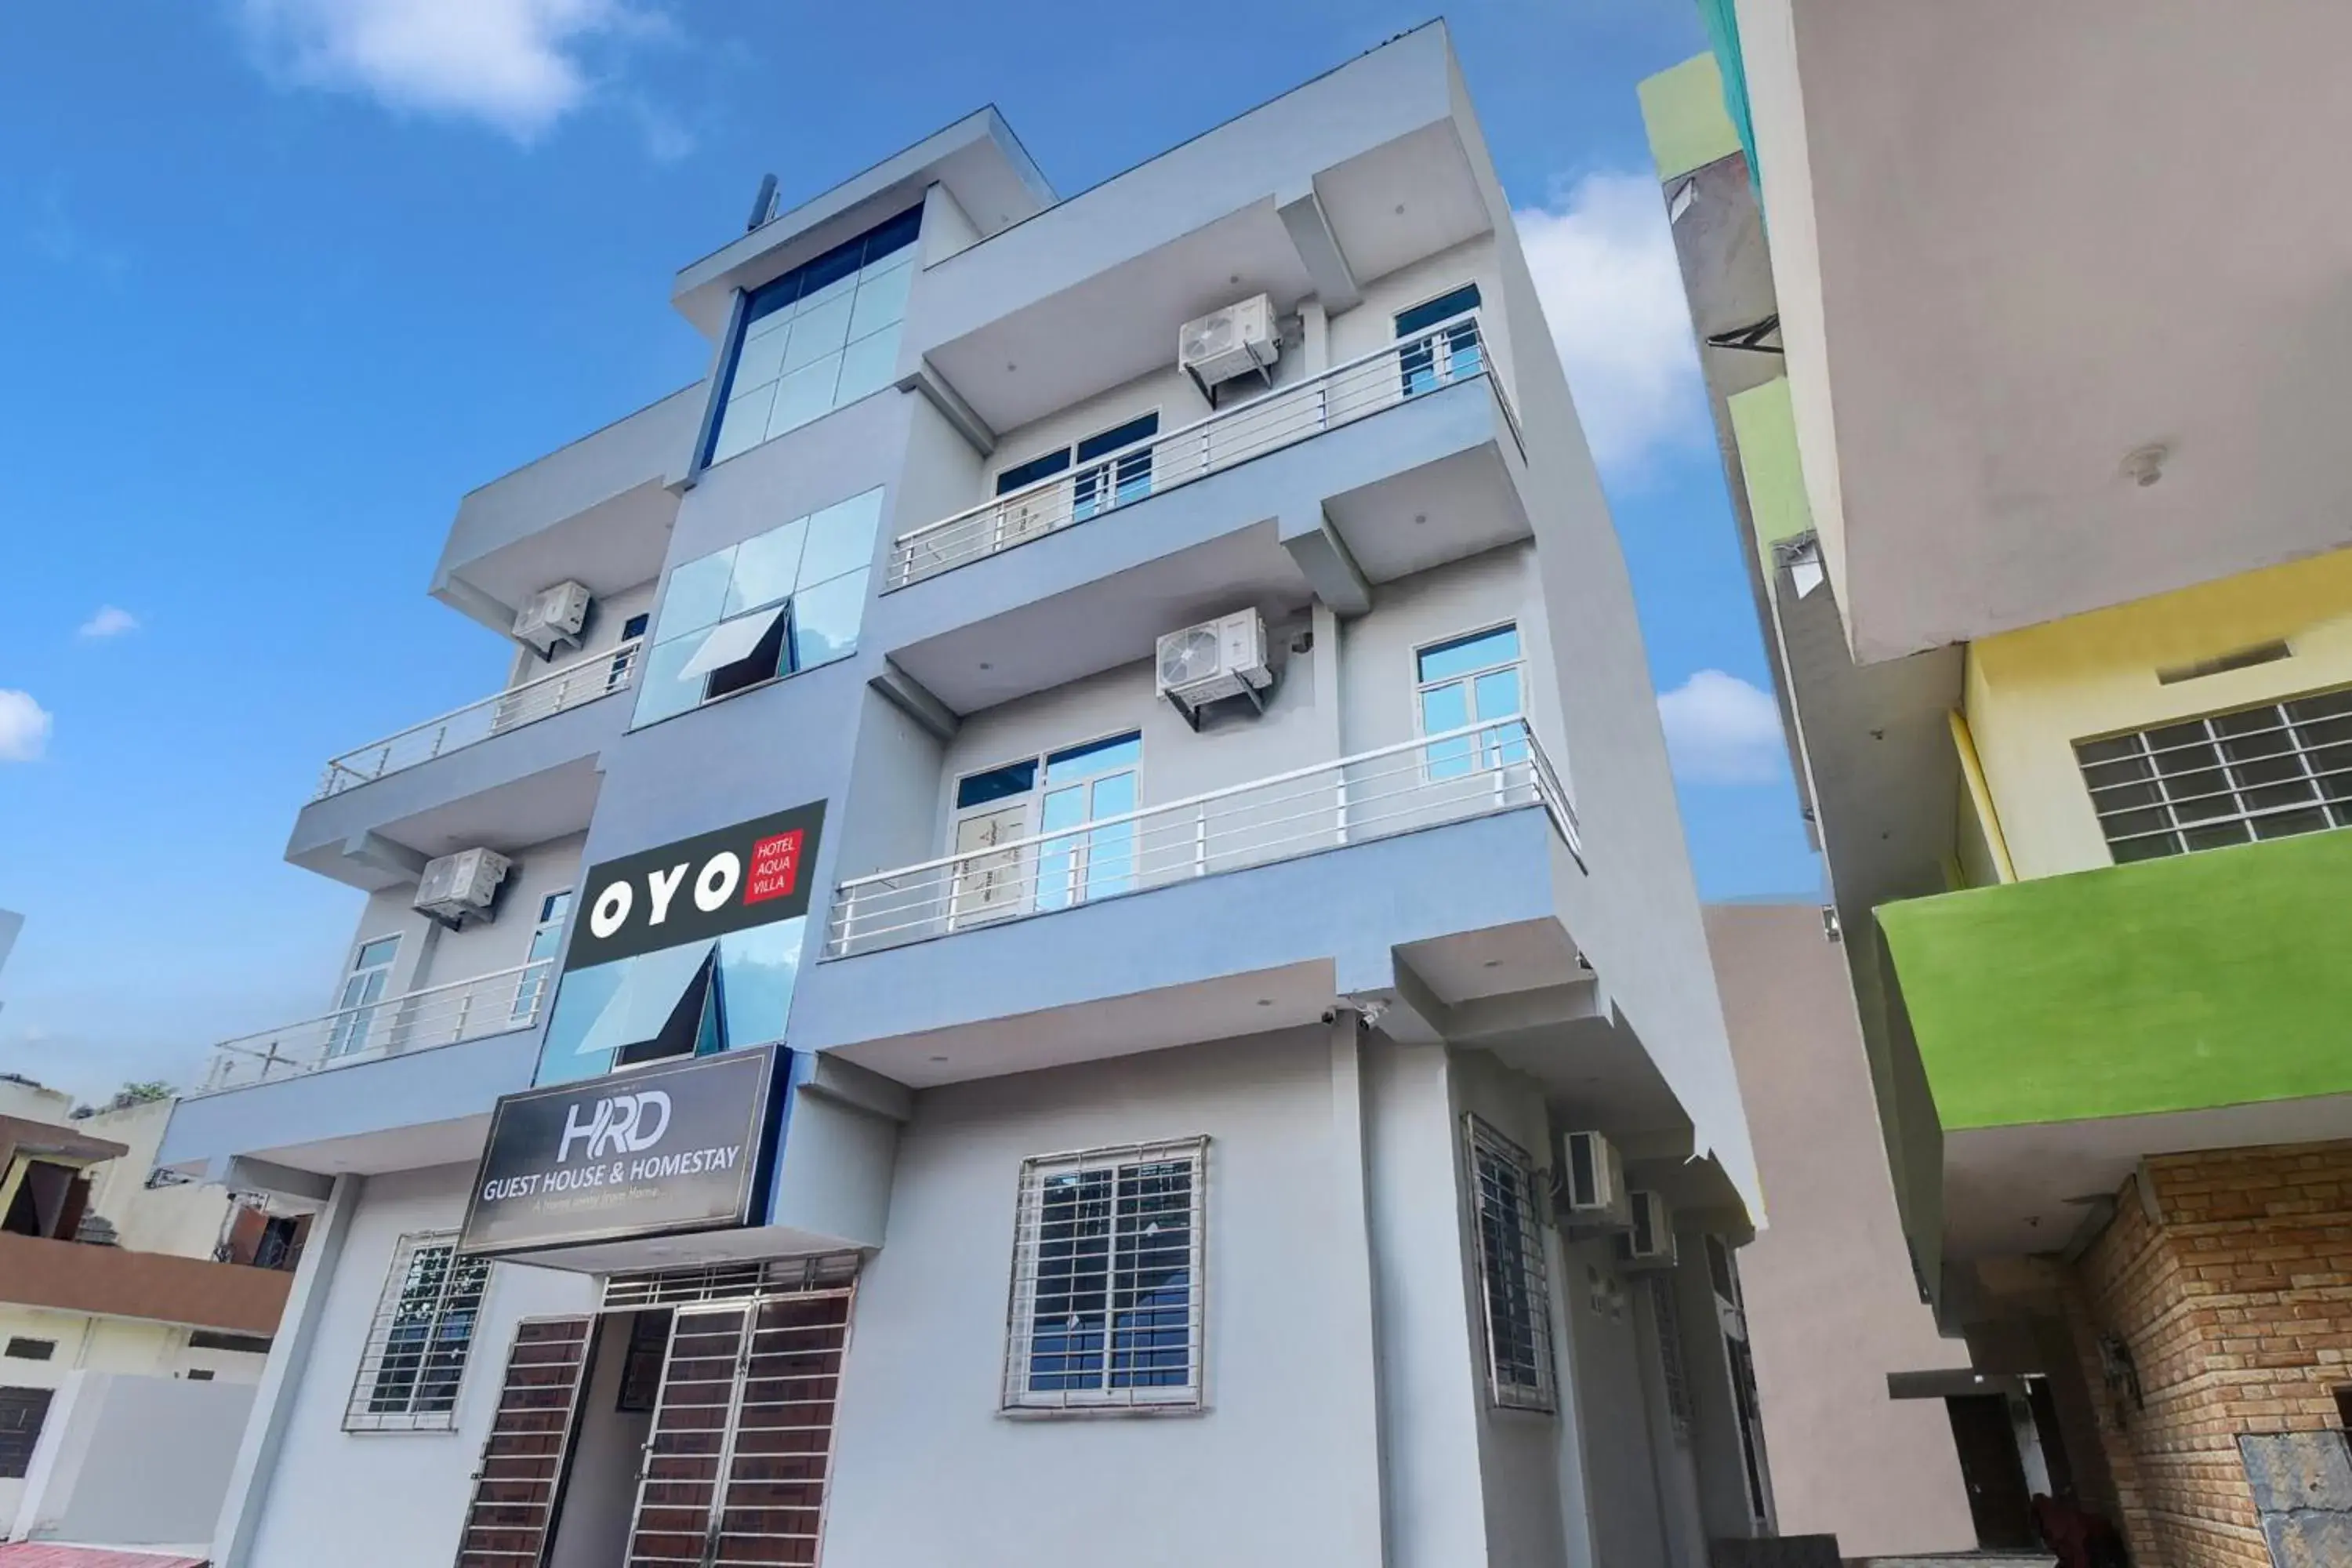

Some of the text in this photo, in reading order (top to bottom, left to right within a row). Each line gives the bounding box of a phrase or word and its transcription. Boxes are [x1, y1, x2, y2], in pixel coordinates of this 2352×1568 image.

[757, 837, 795, 858] HOTEL
[757, 856, 790, 876] AQUA
[590, 851, 741, 938] OYO
[753, 875, 785, 894] VILLA
[557, 1091, 672, 1163] HRD
[484, 1145, 740, 1200] GUEST HOUSE & HOMESTAY
